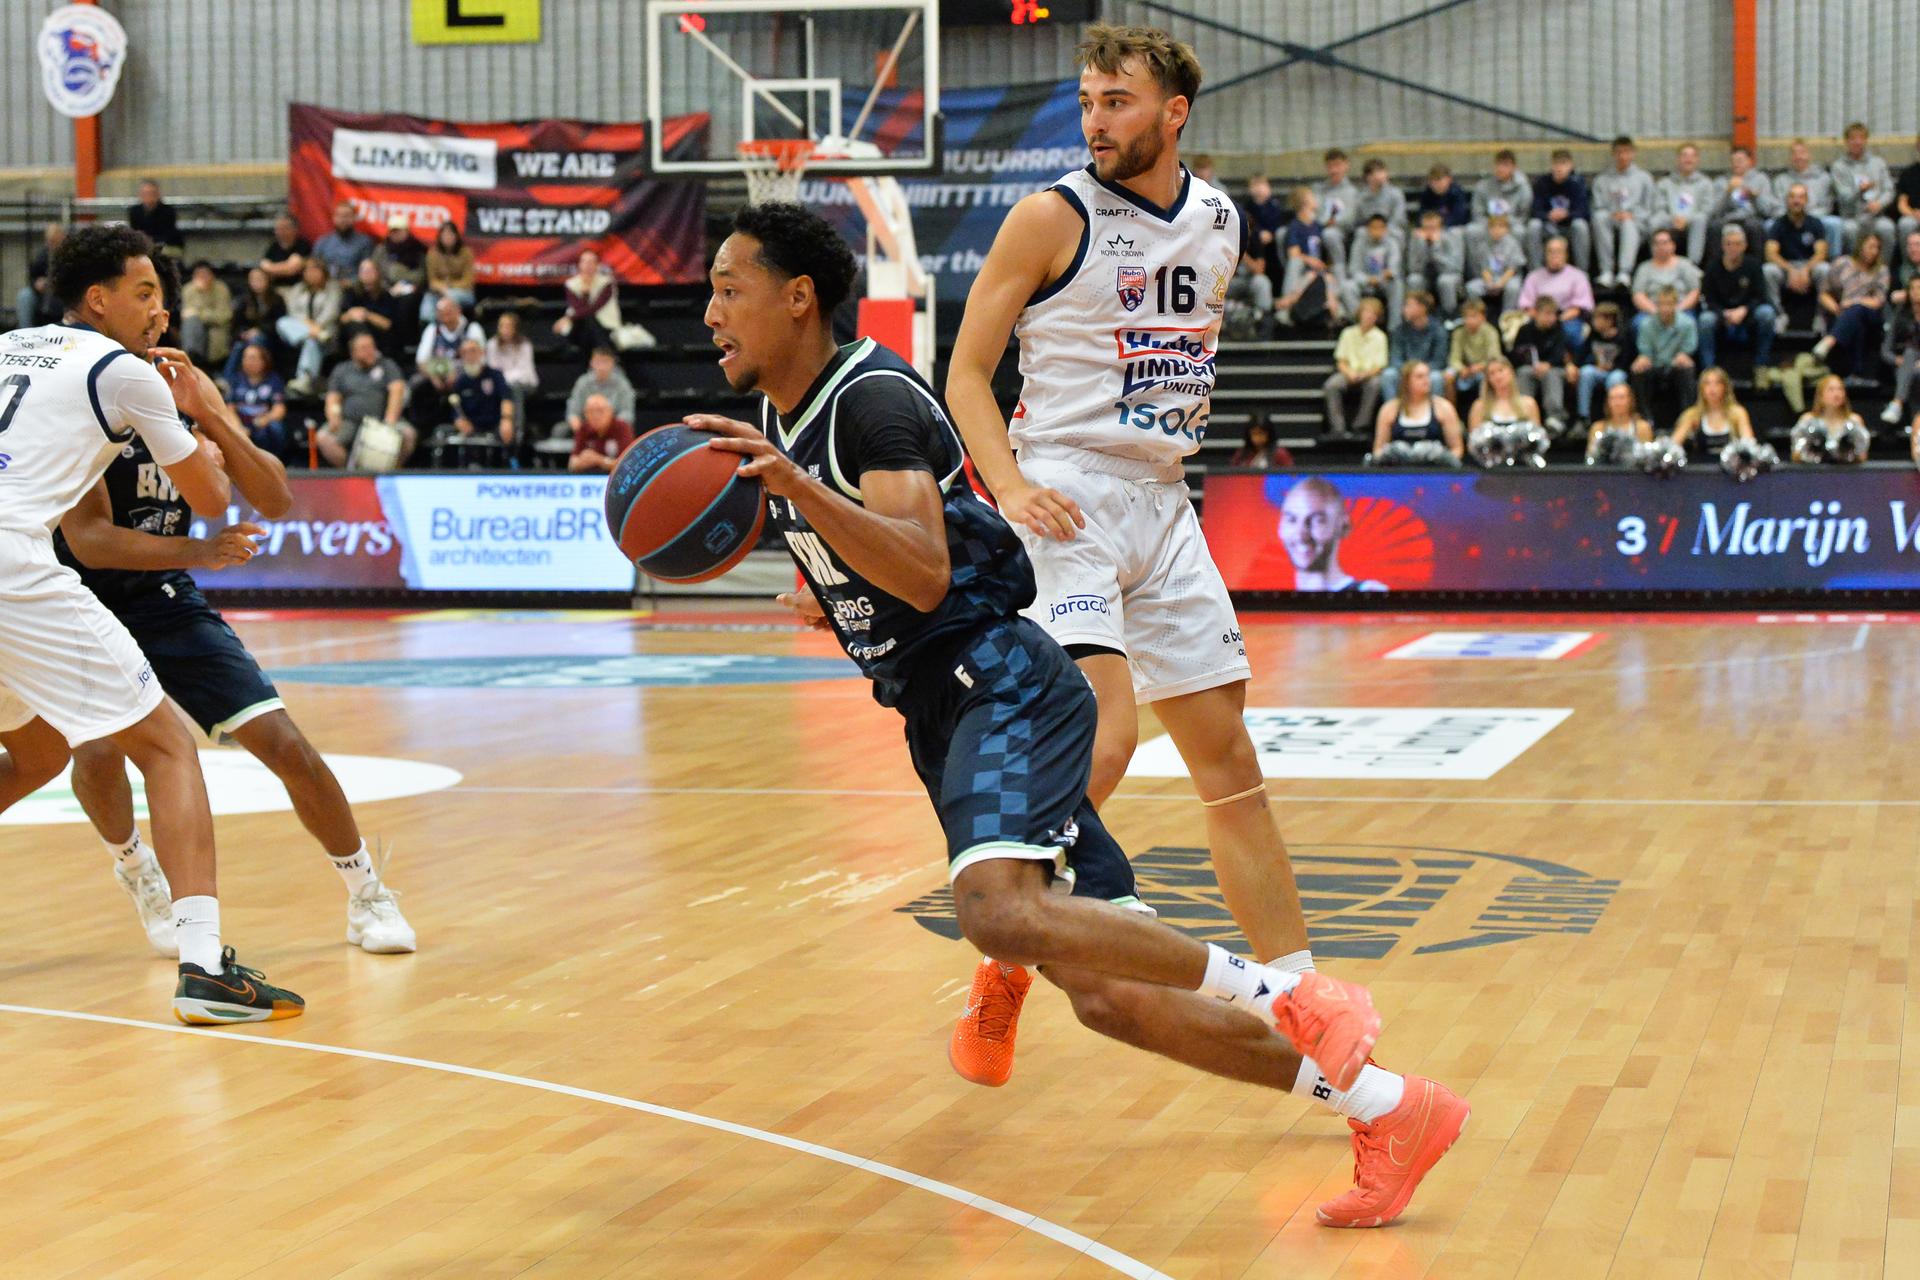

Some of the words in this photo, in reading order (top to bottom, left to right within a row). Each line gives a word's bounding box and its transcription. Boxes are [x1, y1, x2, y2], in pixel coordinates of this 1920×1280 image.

[352, 146, 480, 173] LIMBURG
[513, 153, 559, 177] WE
[562, 153, 616, 177] ARE
[477, 208, 522, 233] WE
[525, 209, 611, 234] STAND
[1095, 208, 1130, 217] CRAFT
[1155, 266, 1198, 316] 16
[0, 353, 62, 369] TERETSE
[1163, 380, 1211, 397] UNITED
[477, 483, 577, 498] POWERED
[580, 483, 604, 498] BY
[1616, 516, 1647, 555] 3
[1691, 501, 1871, 567] Marijn
[428, 547, 551, 565] architecten
